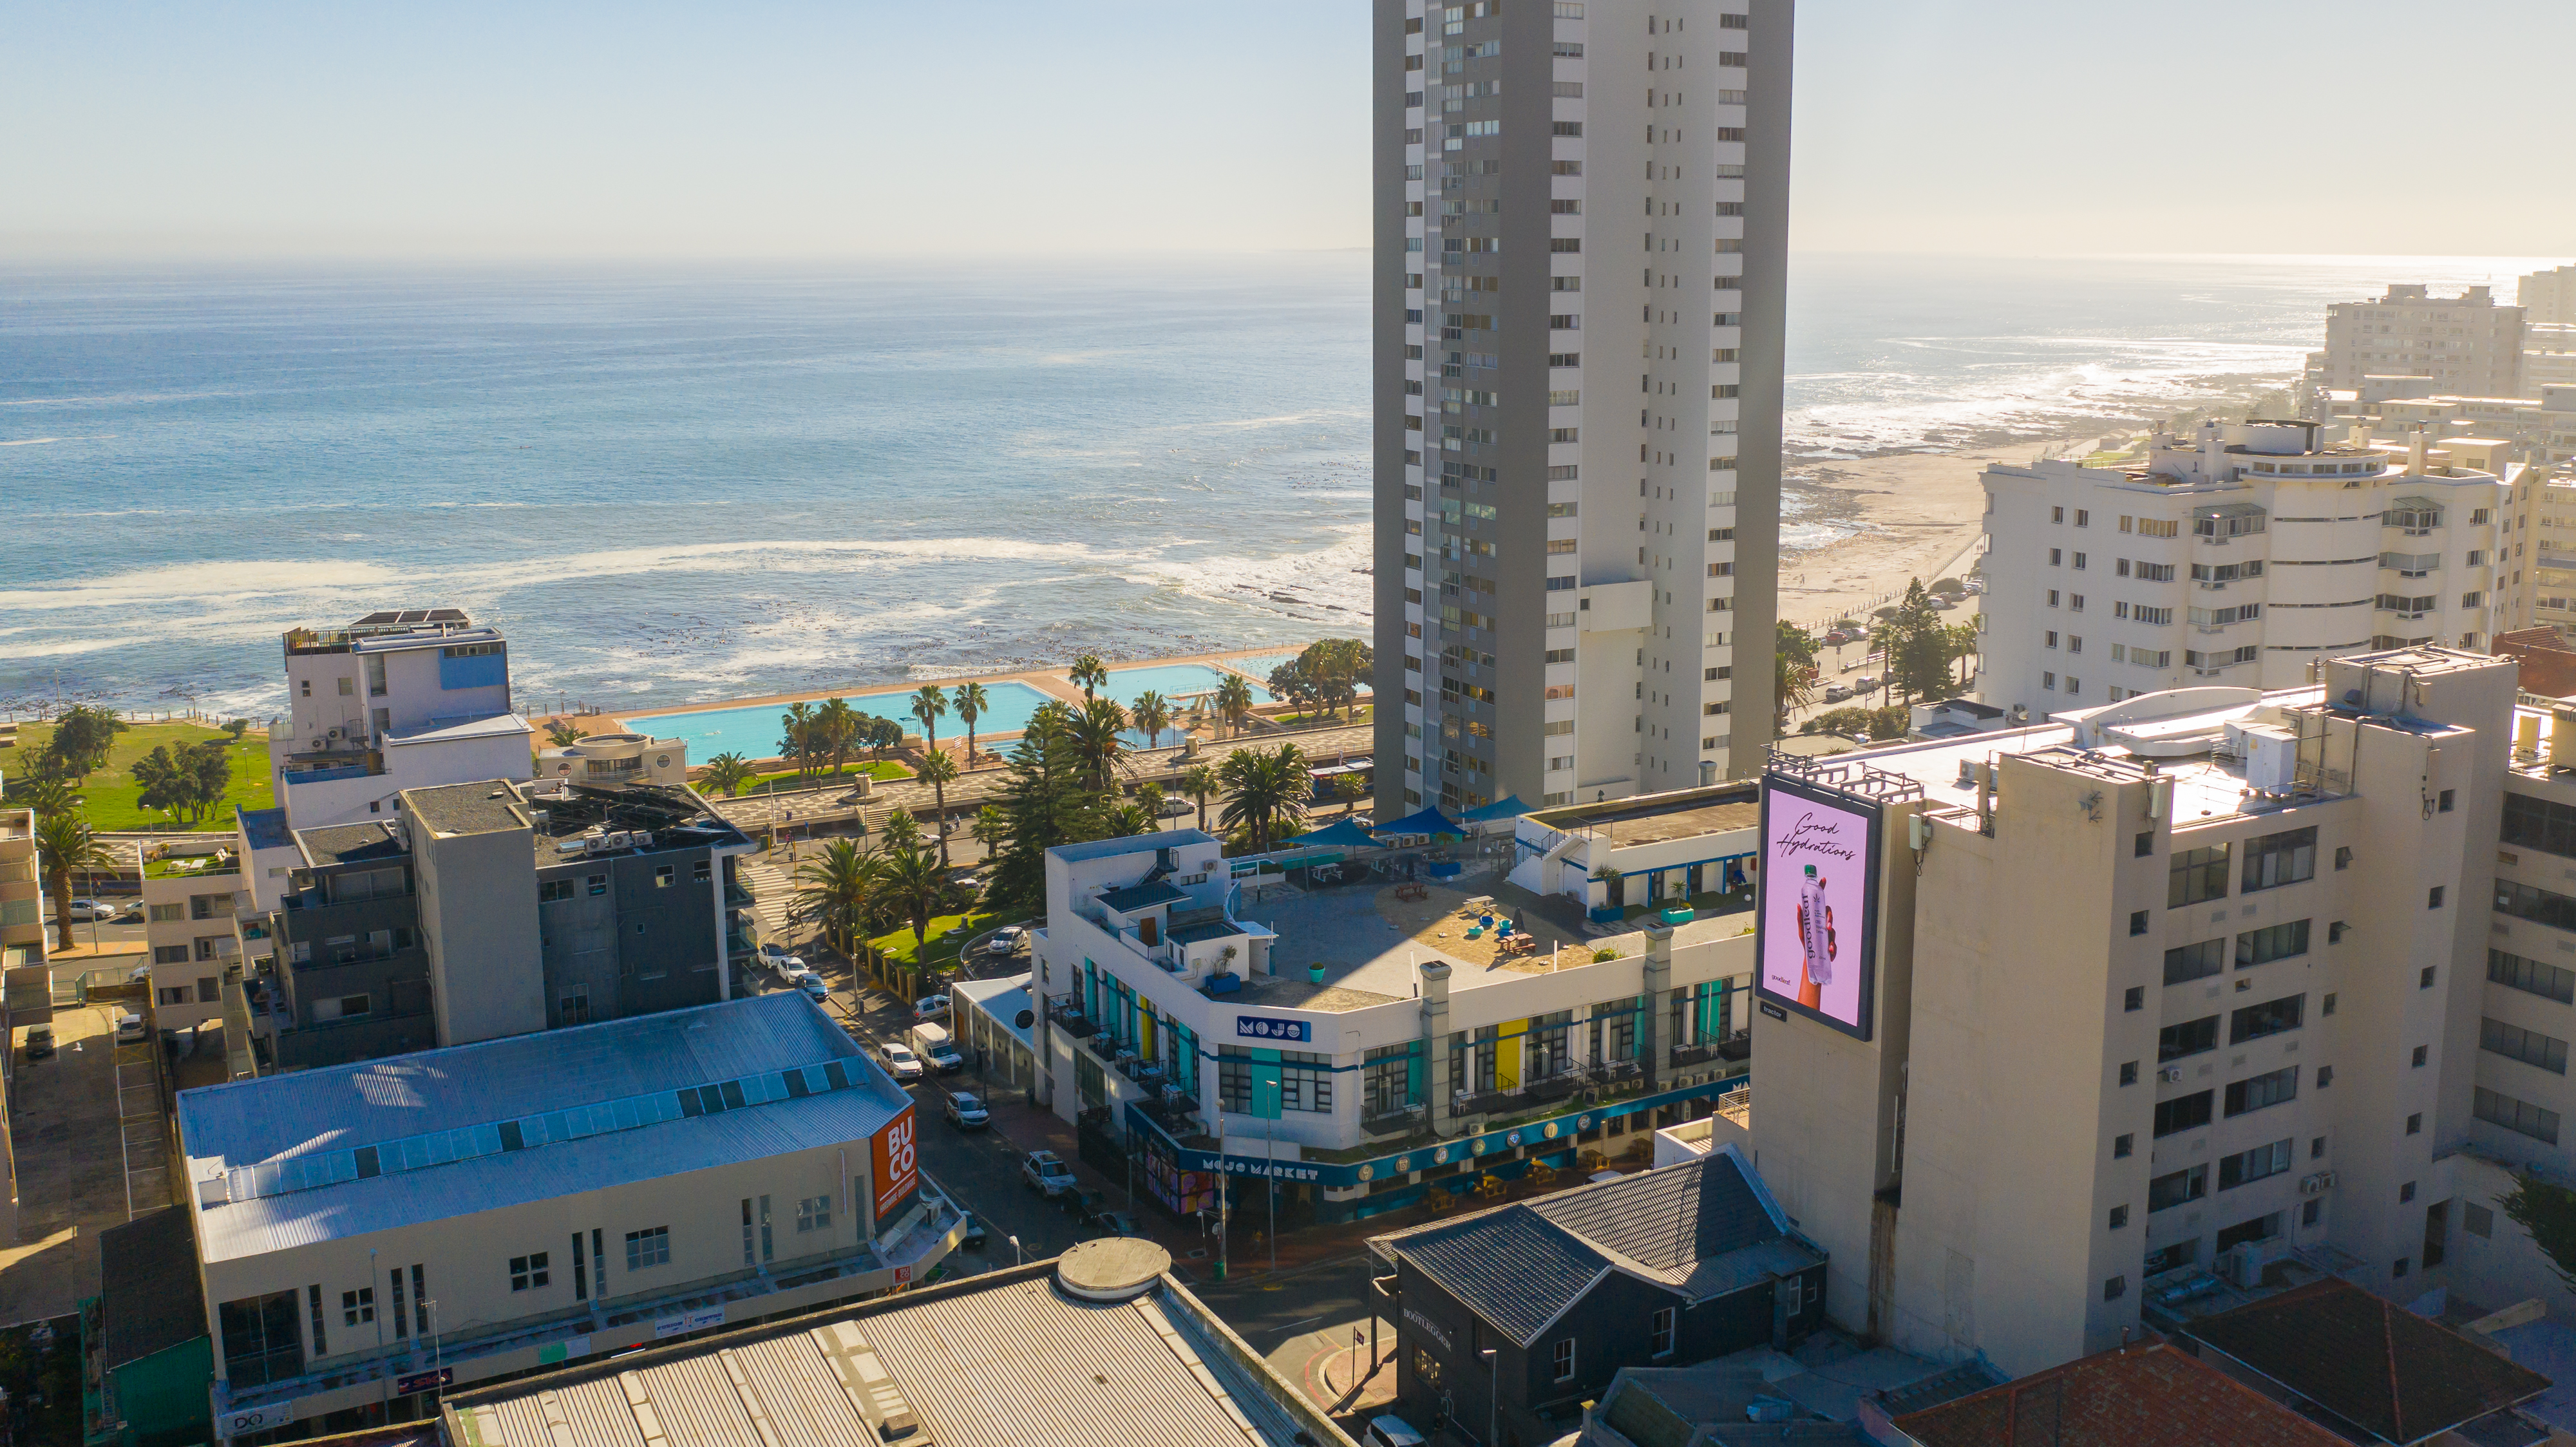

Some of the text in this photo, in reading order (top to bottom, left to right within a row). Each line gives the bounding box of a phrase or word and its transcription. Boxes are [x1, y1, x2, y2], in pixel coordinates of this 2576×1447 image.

[1794, 812, 1839, 835] Good
[1776, 829, 1856, 861] Hydrations
[1801, 893, 1815, 959] goodleaf
[1763, 1006, 1781, 1017] tractor
[1240, 1020, 1300, 1037] MOJO
[888, 1115, 913, 1157] BU
[889, 1143, 914, 1181] CO
[1203, 1159, 1318, 1180] MOJO MARKET
[1403, 1307, 1452, 1352] BOOTLEGGER
